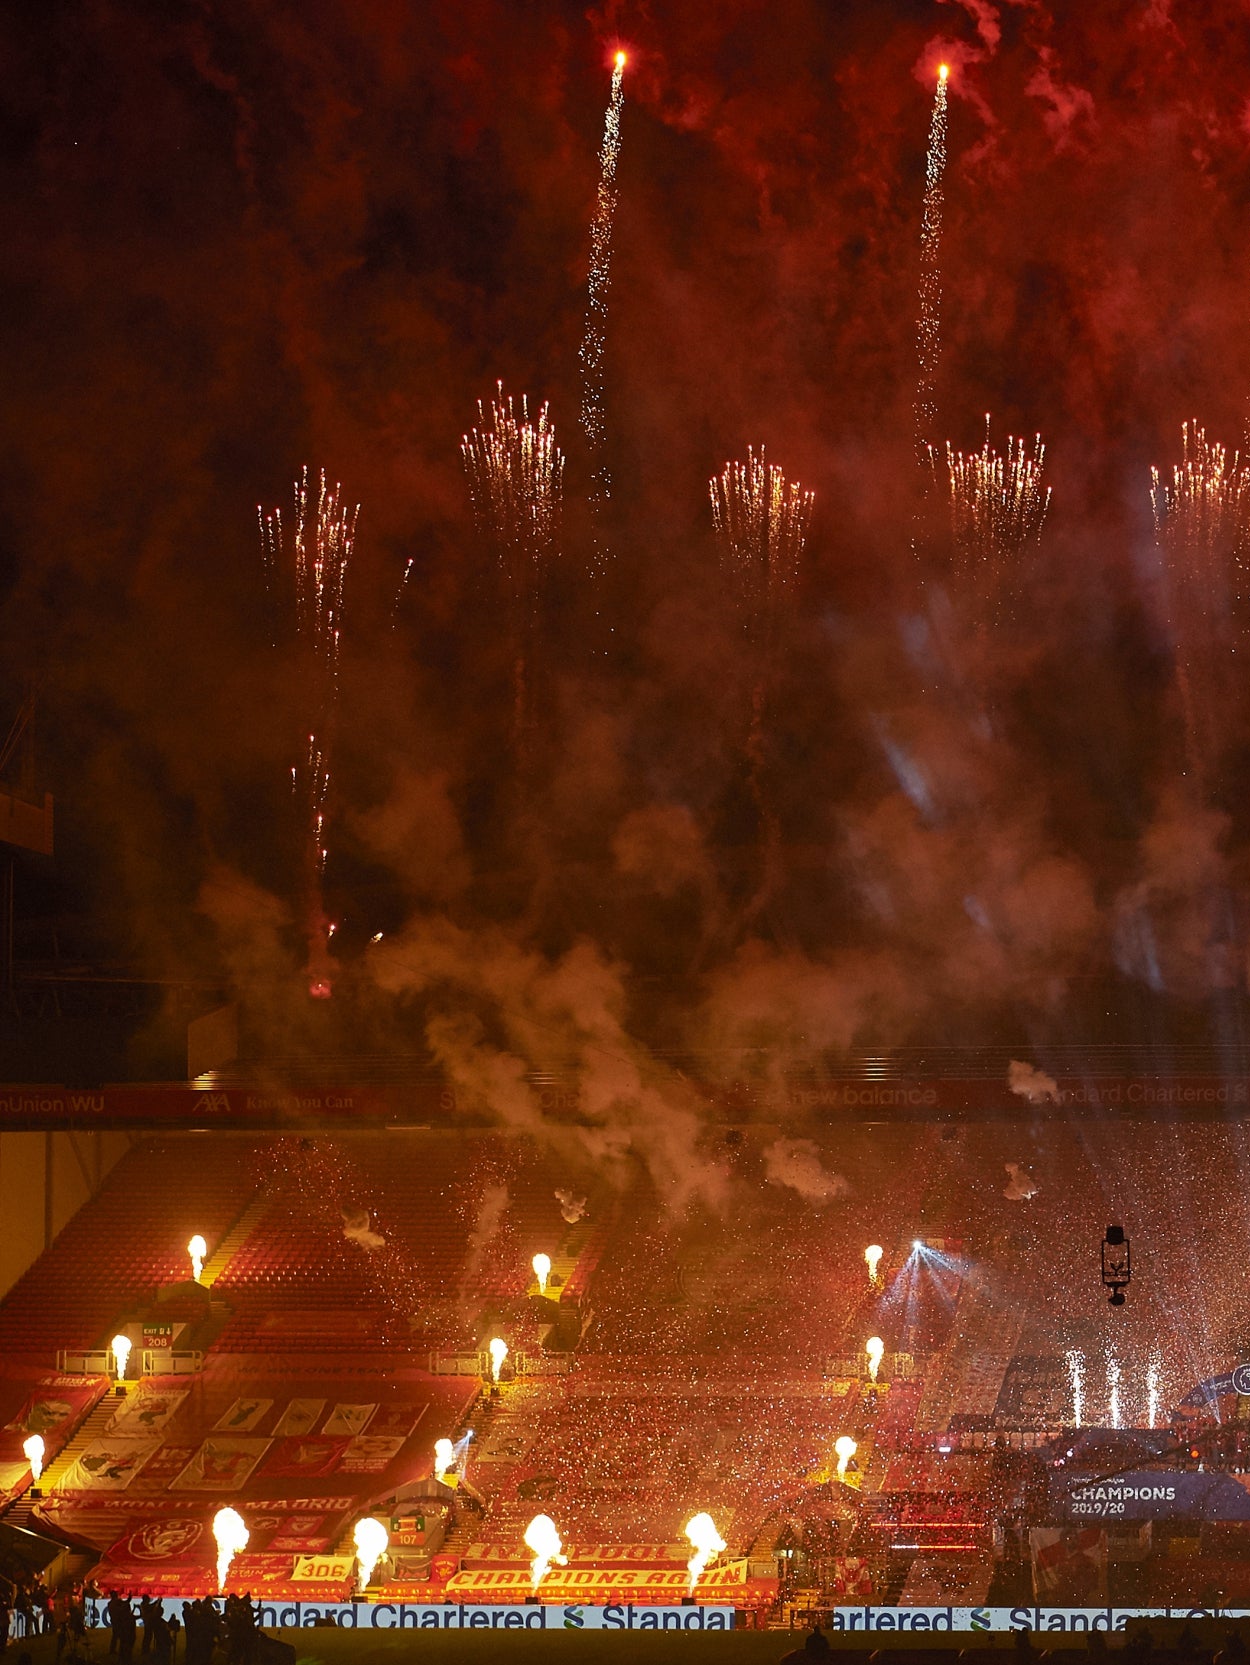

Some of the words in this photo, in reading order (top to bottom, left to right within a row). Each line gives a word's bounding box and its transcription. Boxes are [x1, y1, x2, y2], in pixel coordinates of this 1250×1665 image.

[793, 1089, 839, 1105] new
[843, 1086, 937, 1105] balance
[1127, 1085, 1229, 1103] Chartered
[72, 1096, 105, 1112] WU
[192, 1094, 231, 1112] AXA
[294, 1095, 322, 1109] You
[325, 1095, 354, 1109] Can
[148, 1337, 167, 1347] 208
[1071, 1487, 1176, 1500] CHAMPIONS
[245, 1498, 353, 1510] MADRID
[1071, 1502, 1125, 1516] 2019/20
[399, 1535, 417, 1545] 107
[459, 1544, 671, 1560] LIVPOOL
[453, 1571, 638, 1585] CHAMPIONS
[645, 1566, 741, 1585] AGAIN
[258, 1602, 358, 1628] ndard
[371, 1603, 546, 1629] Chartered
[1008, 1608, 1170, 1632] Standa
